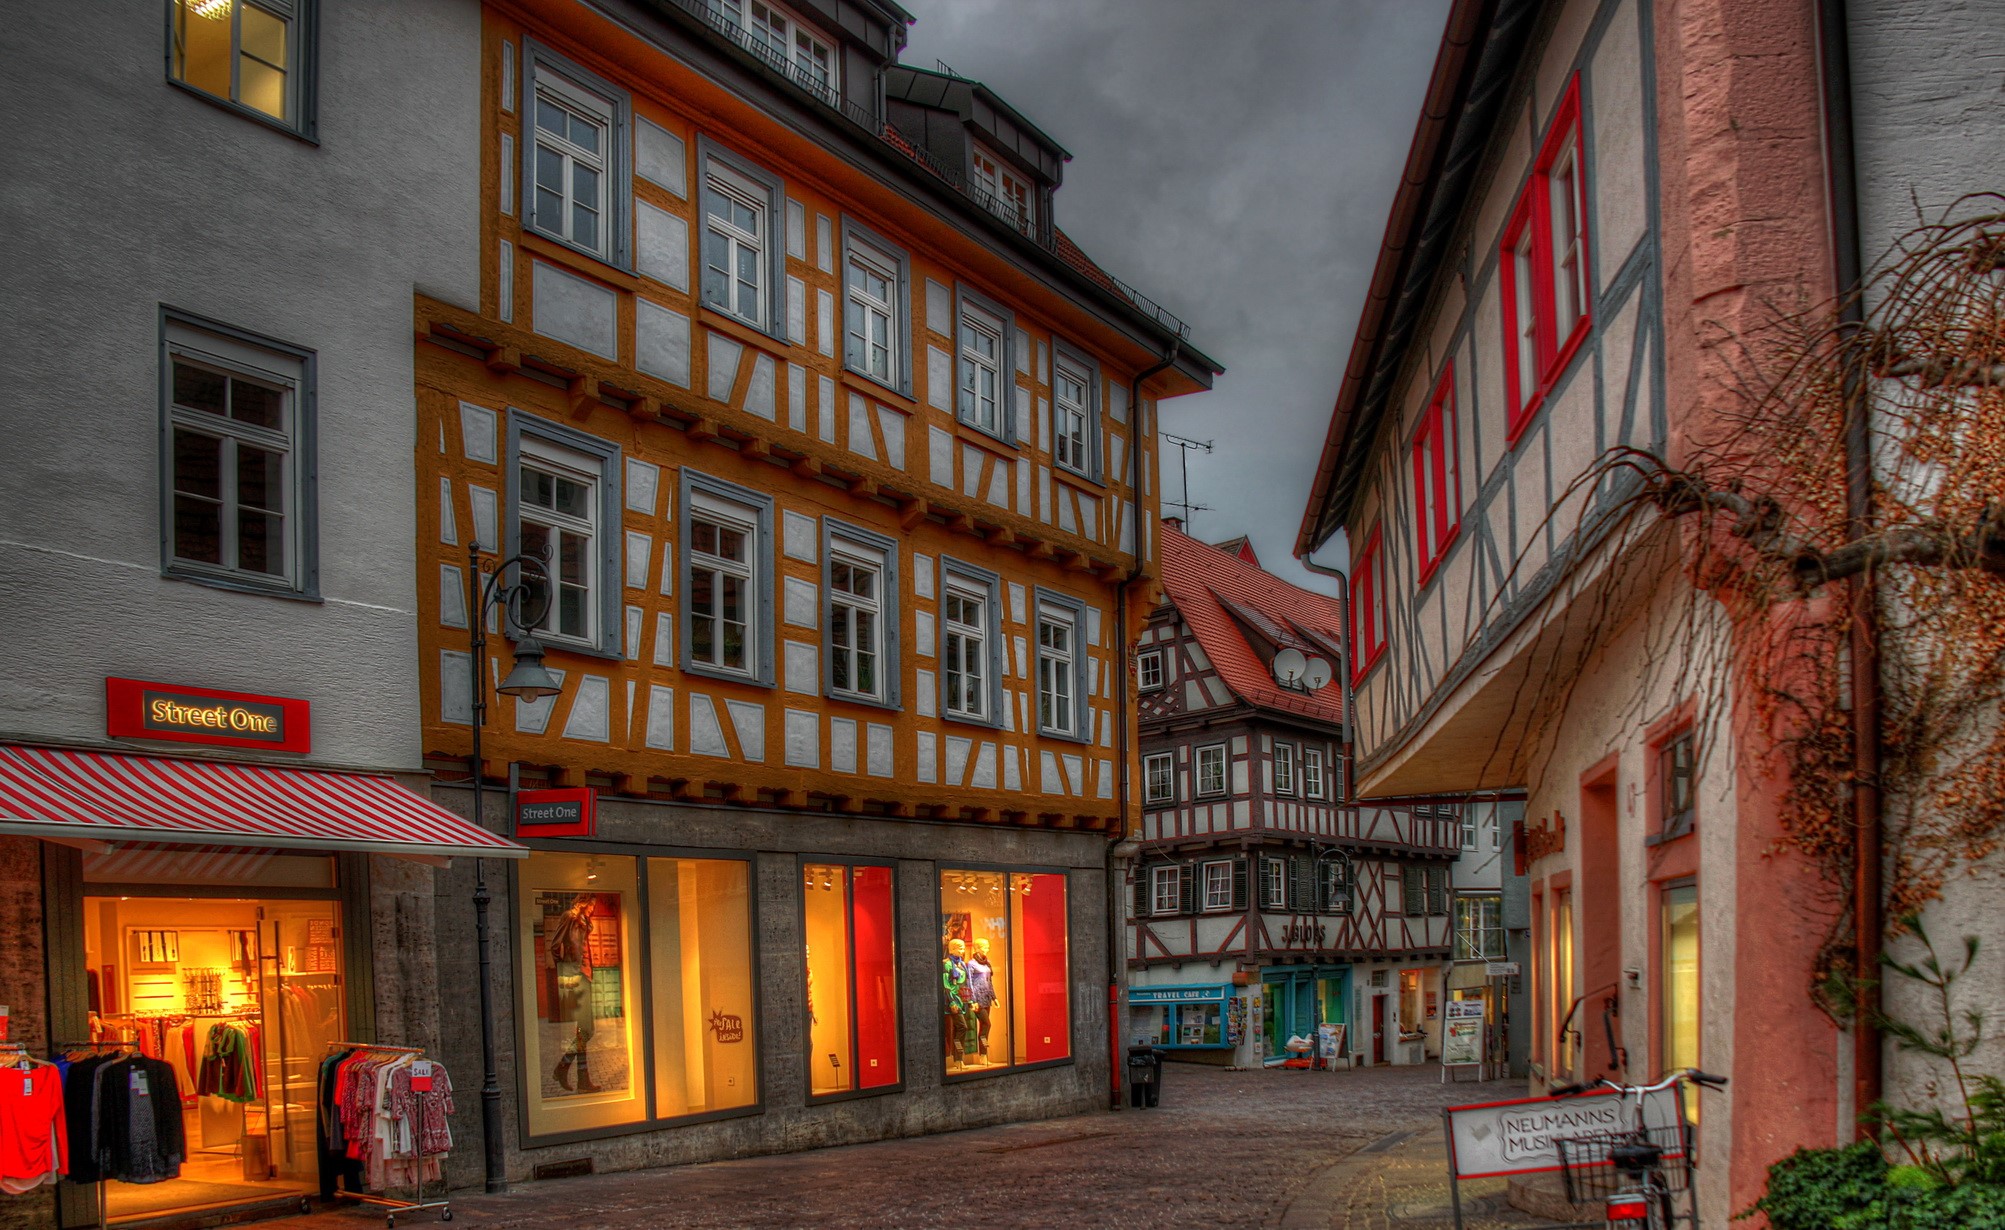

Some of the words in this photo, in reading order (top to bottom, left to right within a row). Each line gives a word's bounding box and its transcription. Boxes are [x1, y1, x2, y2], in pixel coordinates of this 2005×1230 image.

[152, 699, 228, 729] Street
[230, 708, 278, 733] One
[522, 807, 554, 820] Street
[555, 806, 578, 819] One
[1152, 991, 1181, 999] TRAVEL
[1506, 1108, 1616, 1134] NEUMANNS
